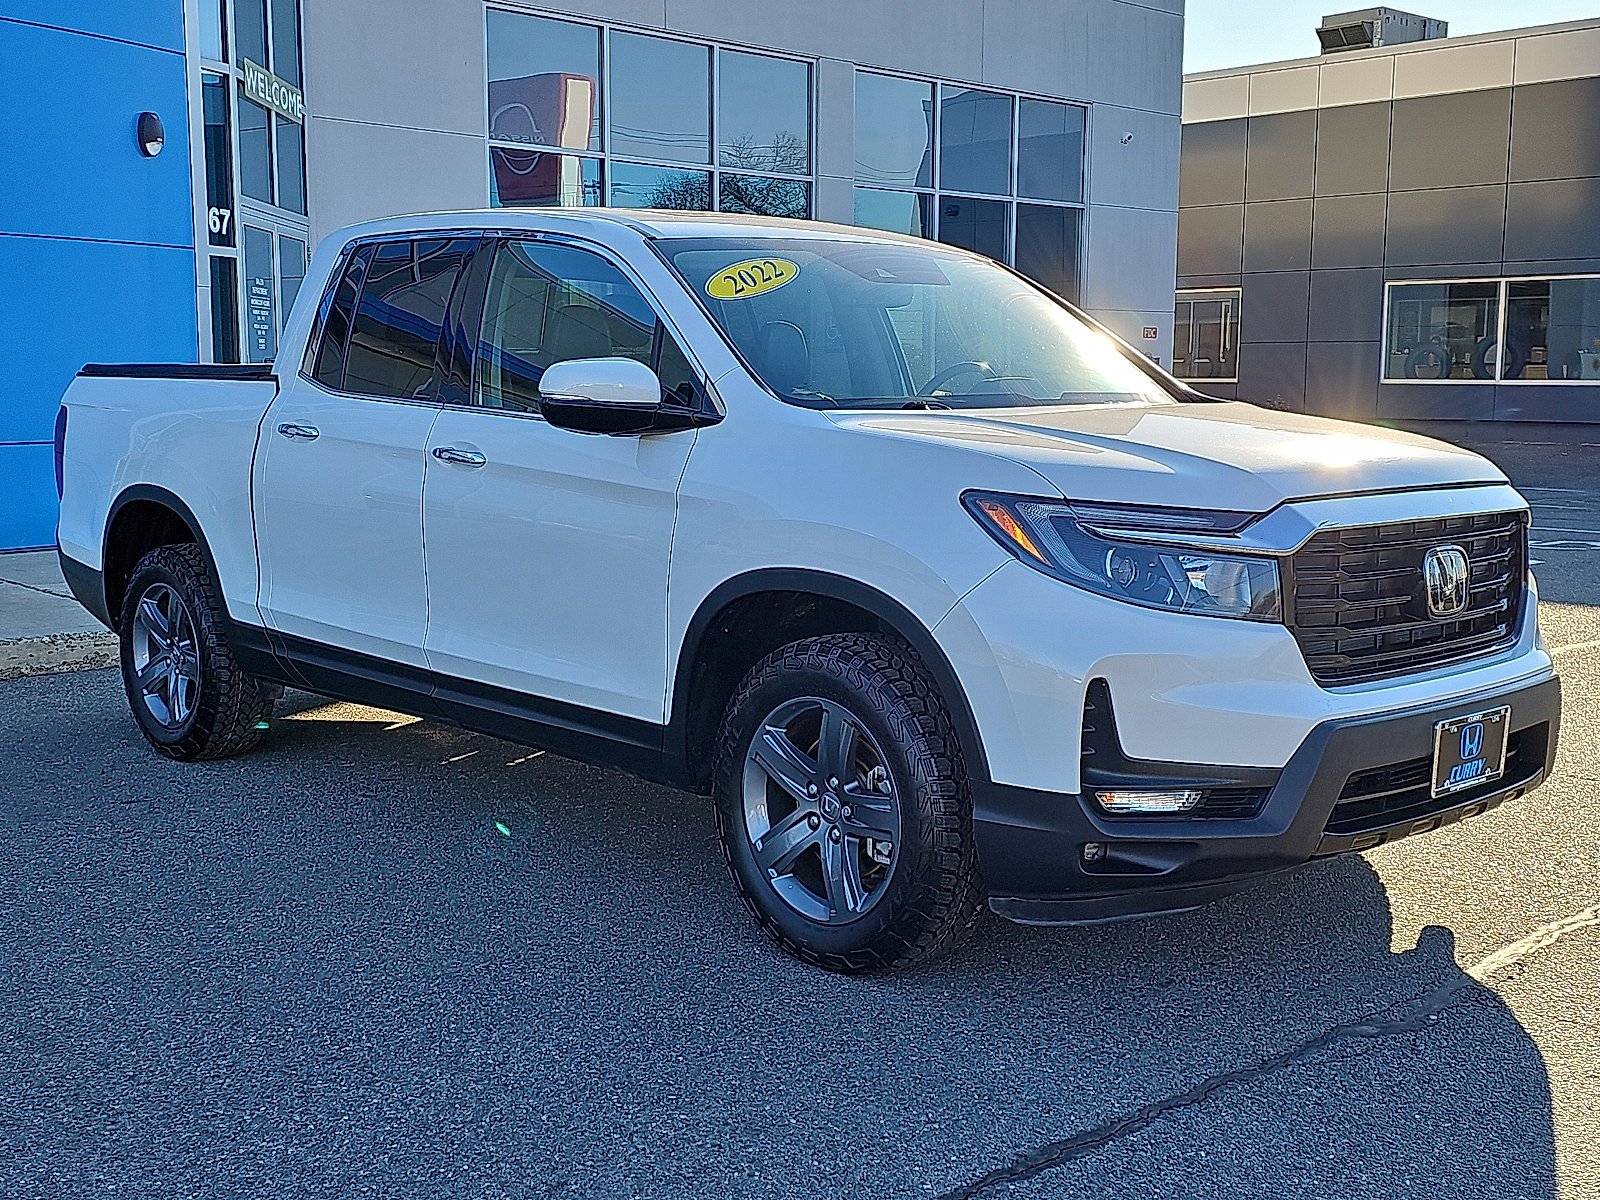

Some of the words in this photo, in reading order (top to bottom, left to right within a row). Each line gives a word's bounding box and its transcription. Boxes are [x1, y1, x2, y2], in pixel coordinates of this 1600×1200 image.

[245, 65, 302, 117] WELCOME
[208, 207, 231, 235] 67
[723, 261, 785, 295] 2022
[1144, 328, 1156, 338] FDC
[1450, 758, 1486, 783] CURRY
